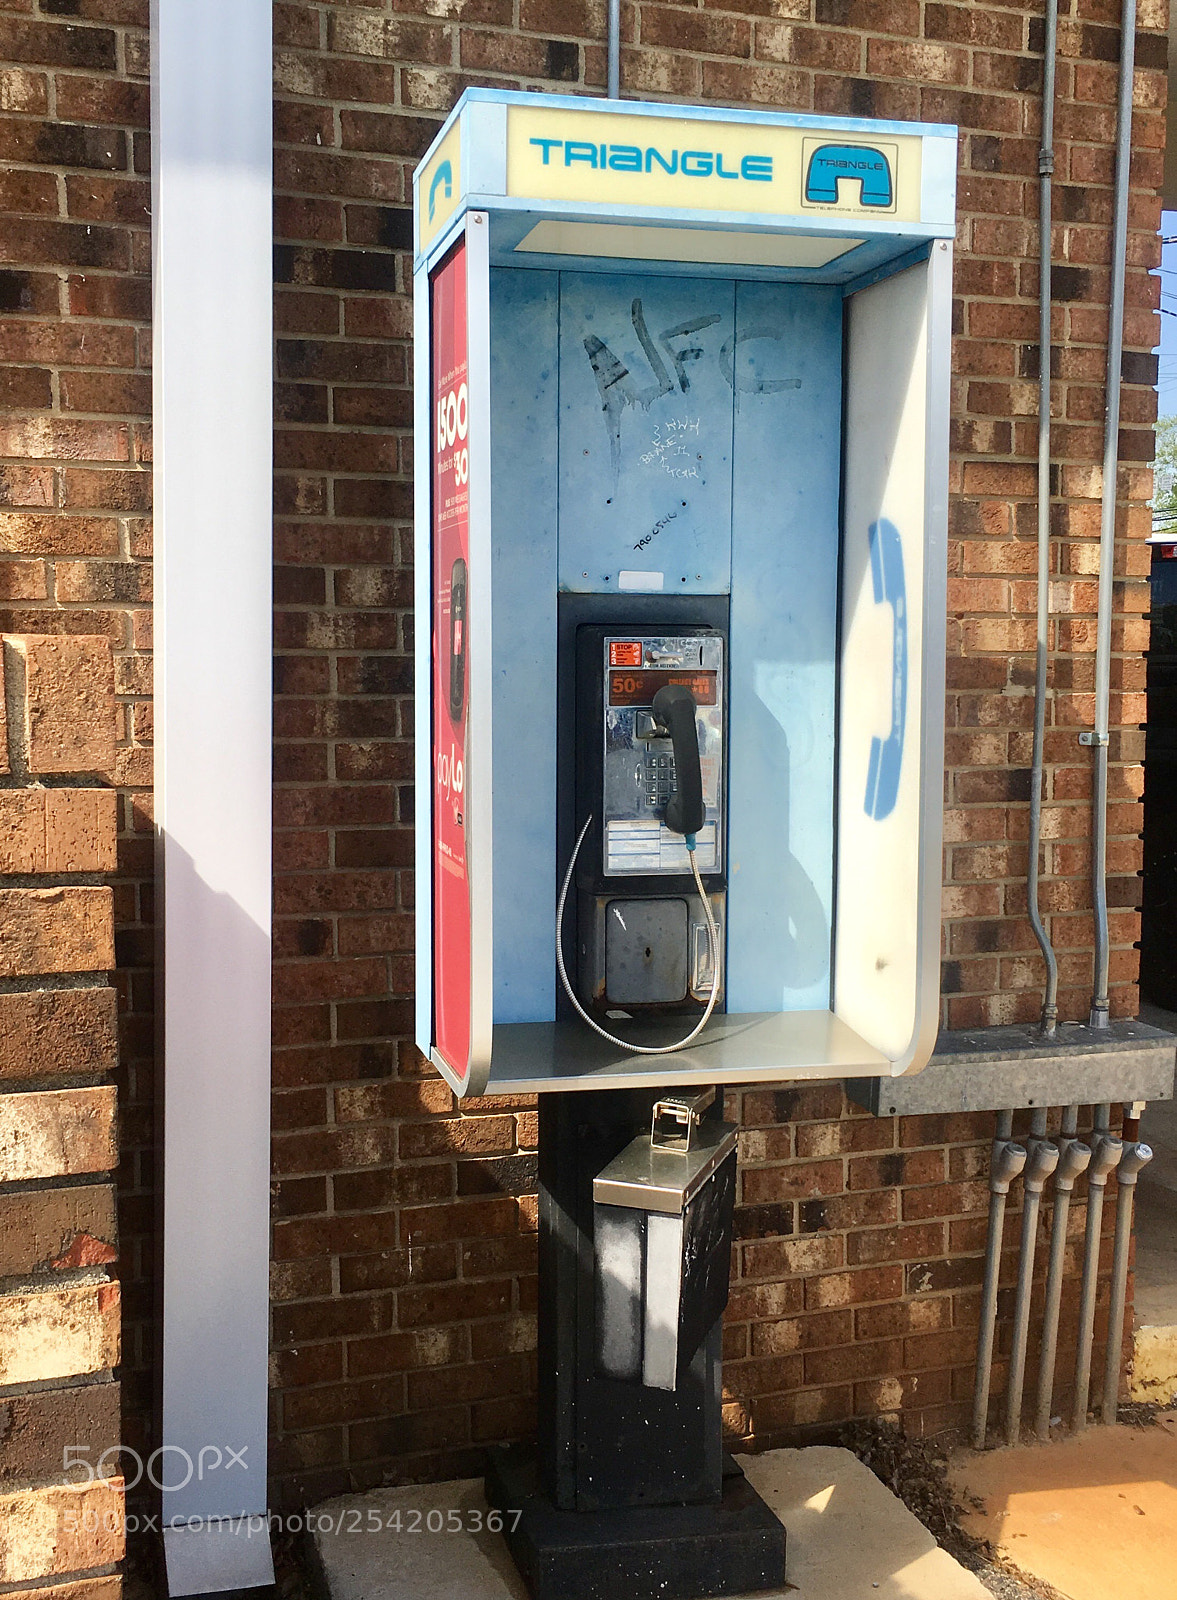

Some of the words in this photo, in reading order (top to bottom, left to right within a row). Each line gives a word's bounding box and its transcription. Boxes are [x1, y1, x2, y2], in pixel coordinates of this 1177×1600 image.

[529, 138, 773, 182] TRIANGLE
[817, 158, 884, 171] TRIANGLE
[437, 382, 468, 453] 1500
